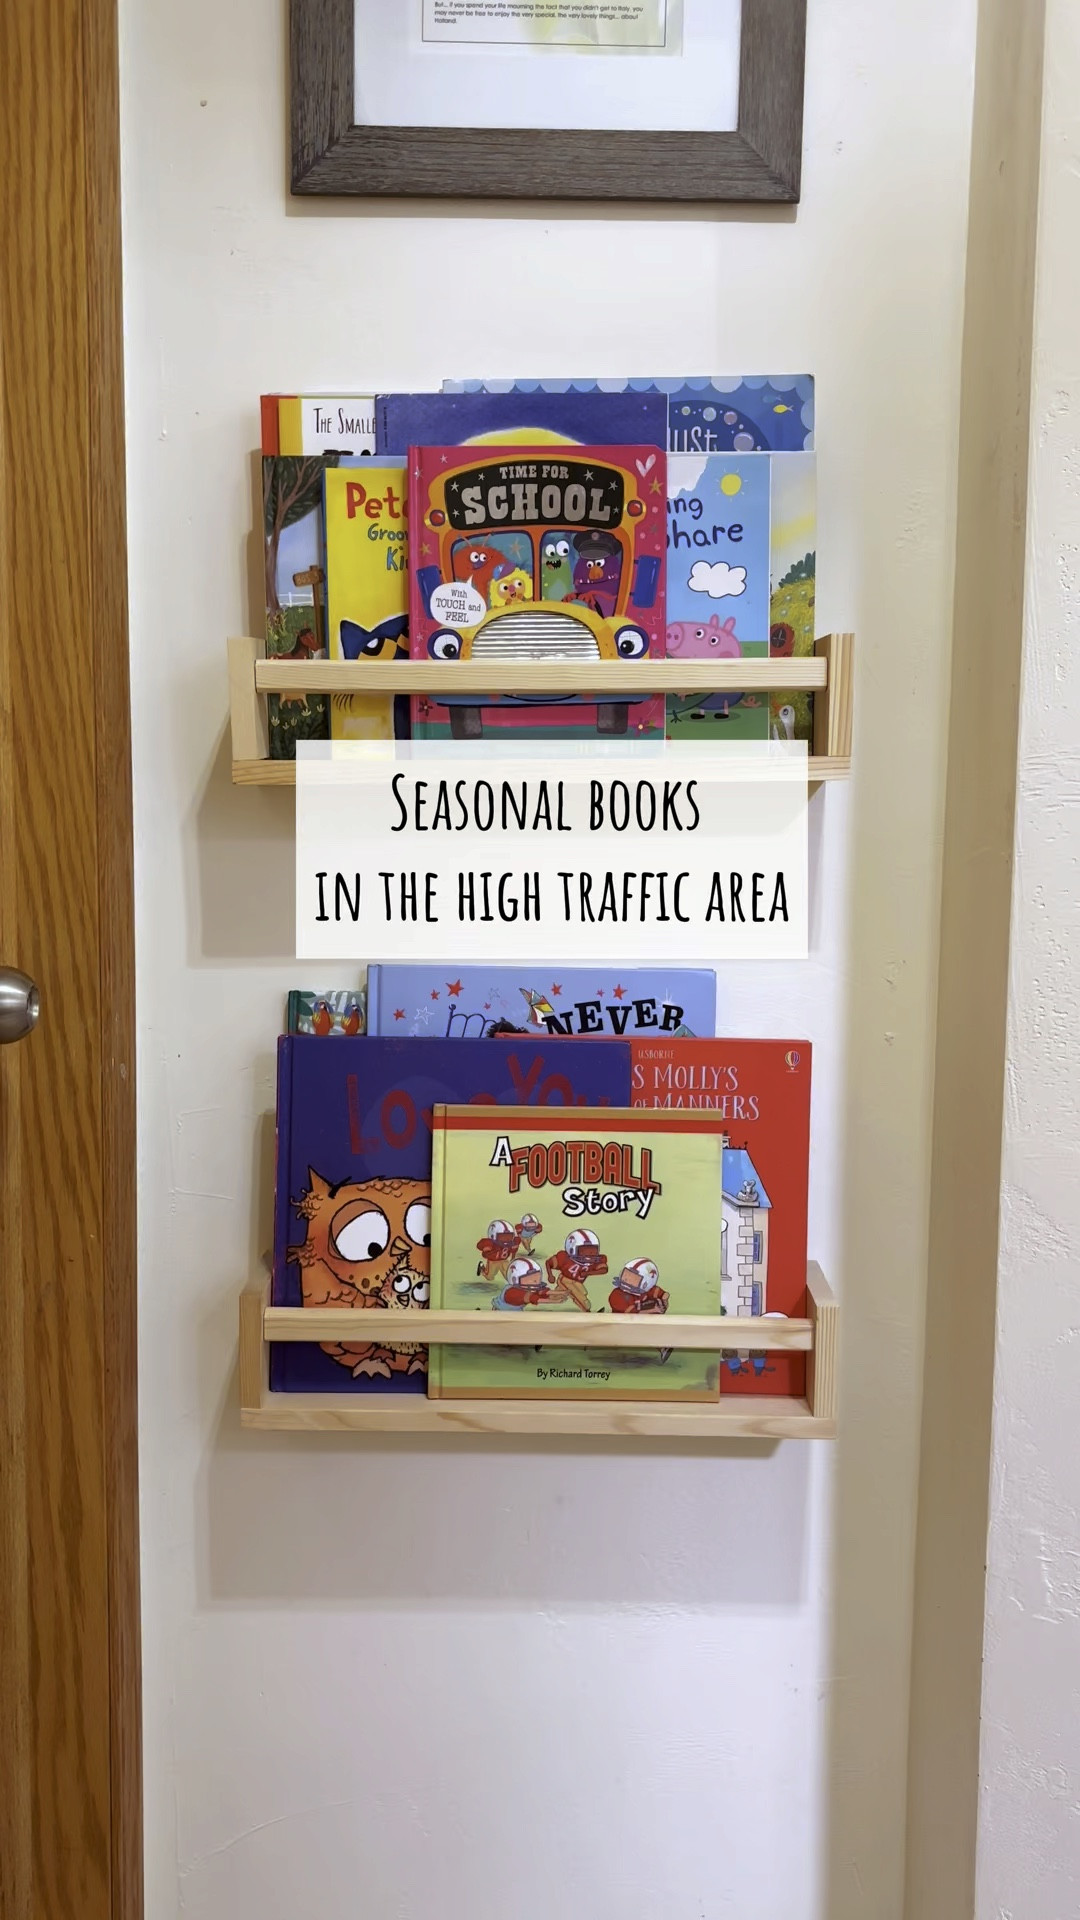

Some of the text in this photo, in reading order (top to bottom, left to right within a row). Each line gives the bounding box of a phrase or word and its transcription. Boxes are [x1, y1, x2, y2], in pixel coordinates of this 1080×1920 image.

[500, 465, 570, 480] TIME FOR
[461, 483, 611, 525] SCHOOL
[666, 519, 744, 549] hare
[436, 597, 481, 612] TOUCH and
[451, 589, 468, 599] With
[445, 611, 469, 623] FEEL
[543, 998, 684, 1035] NEVER
[653, 1064, 738, 1091] MOLLY'S
[653, 1092, 760, 1121] MANNERS
[489, 1136, 514, 1167] A
[509, 1140, 662, 1194] FOOTBALL
[562, 1186, 656, 1220] Story
[537, 1363, 611, 1381] By Richard Torrey
